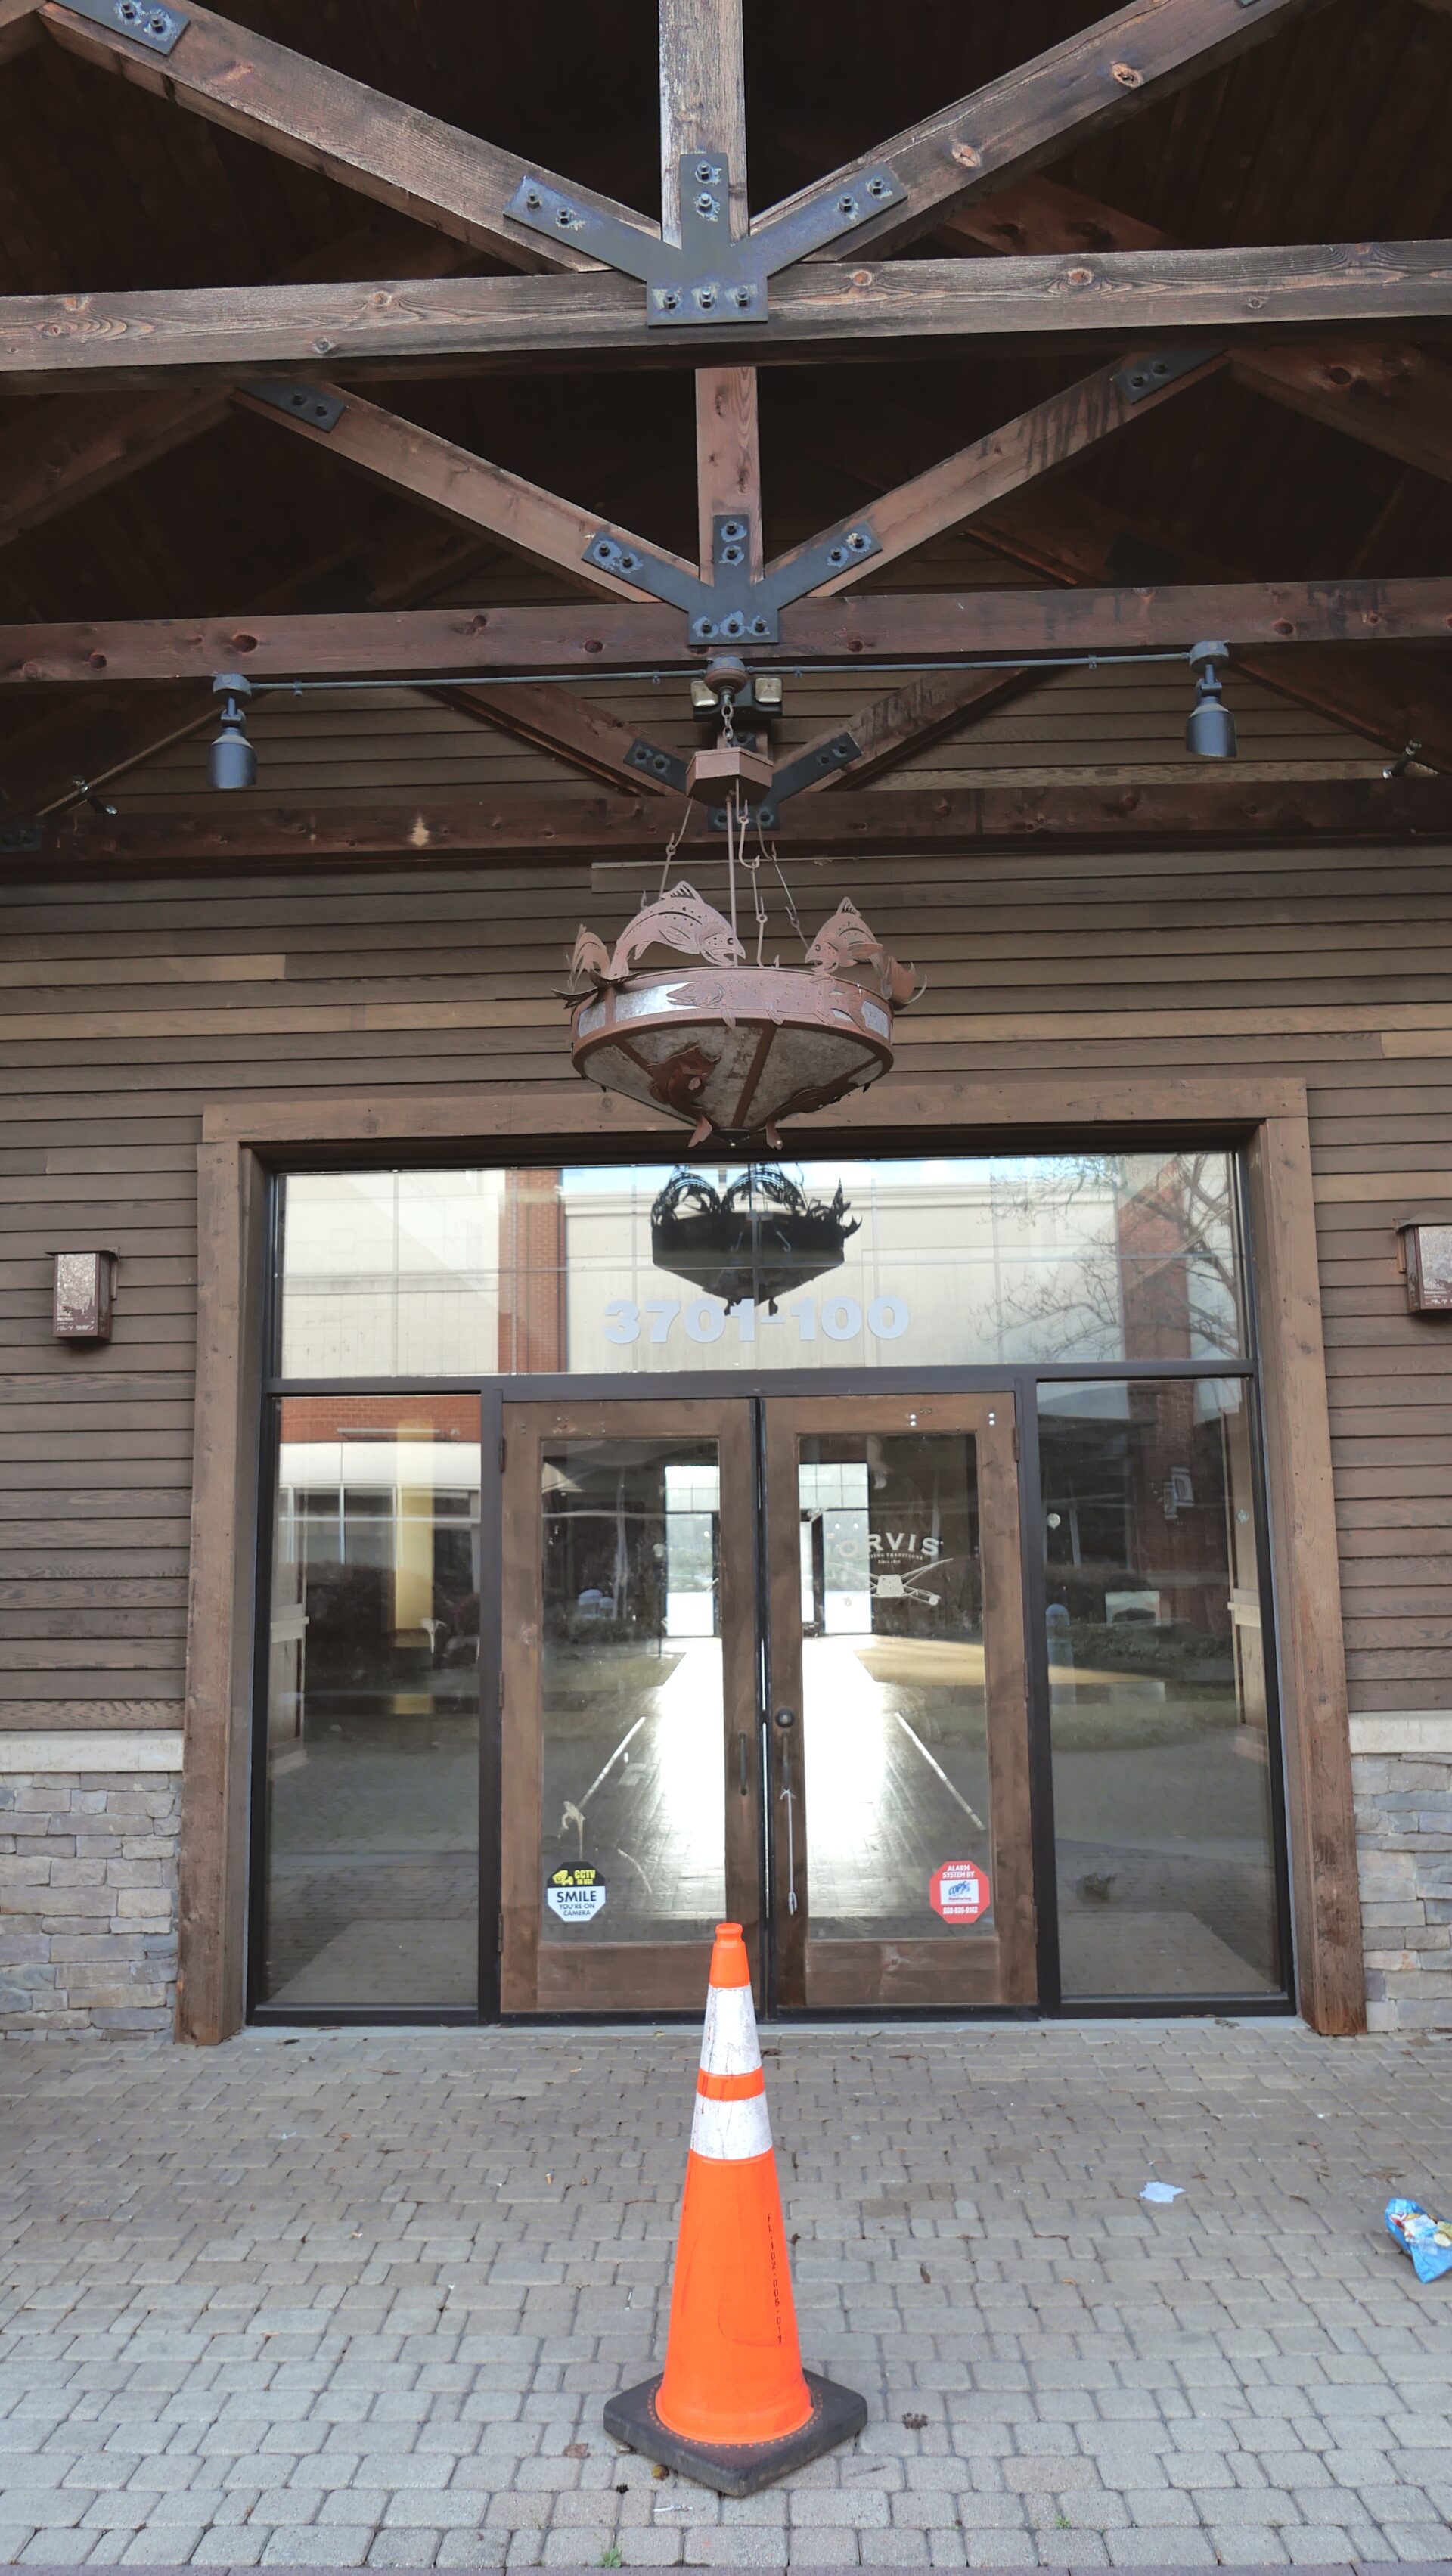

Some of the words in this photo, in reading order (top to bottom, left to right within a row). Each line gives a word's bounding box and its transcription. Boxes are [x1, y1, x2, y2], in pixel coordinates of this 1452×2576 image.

[604, 1296, 910, 1344] 3701-100
[574, 1869, 596, 1879] CCTV
[557, 1890, 597, 1903] SMILE
